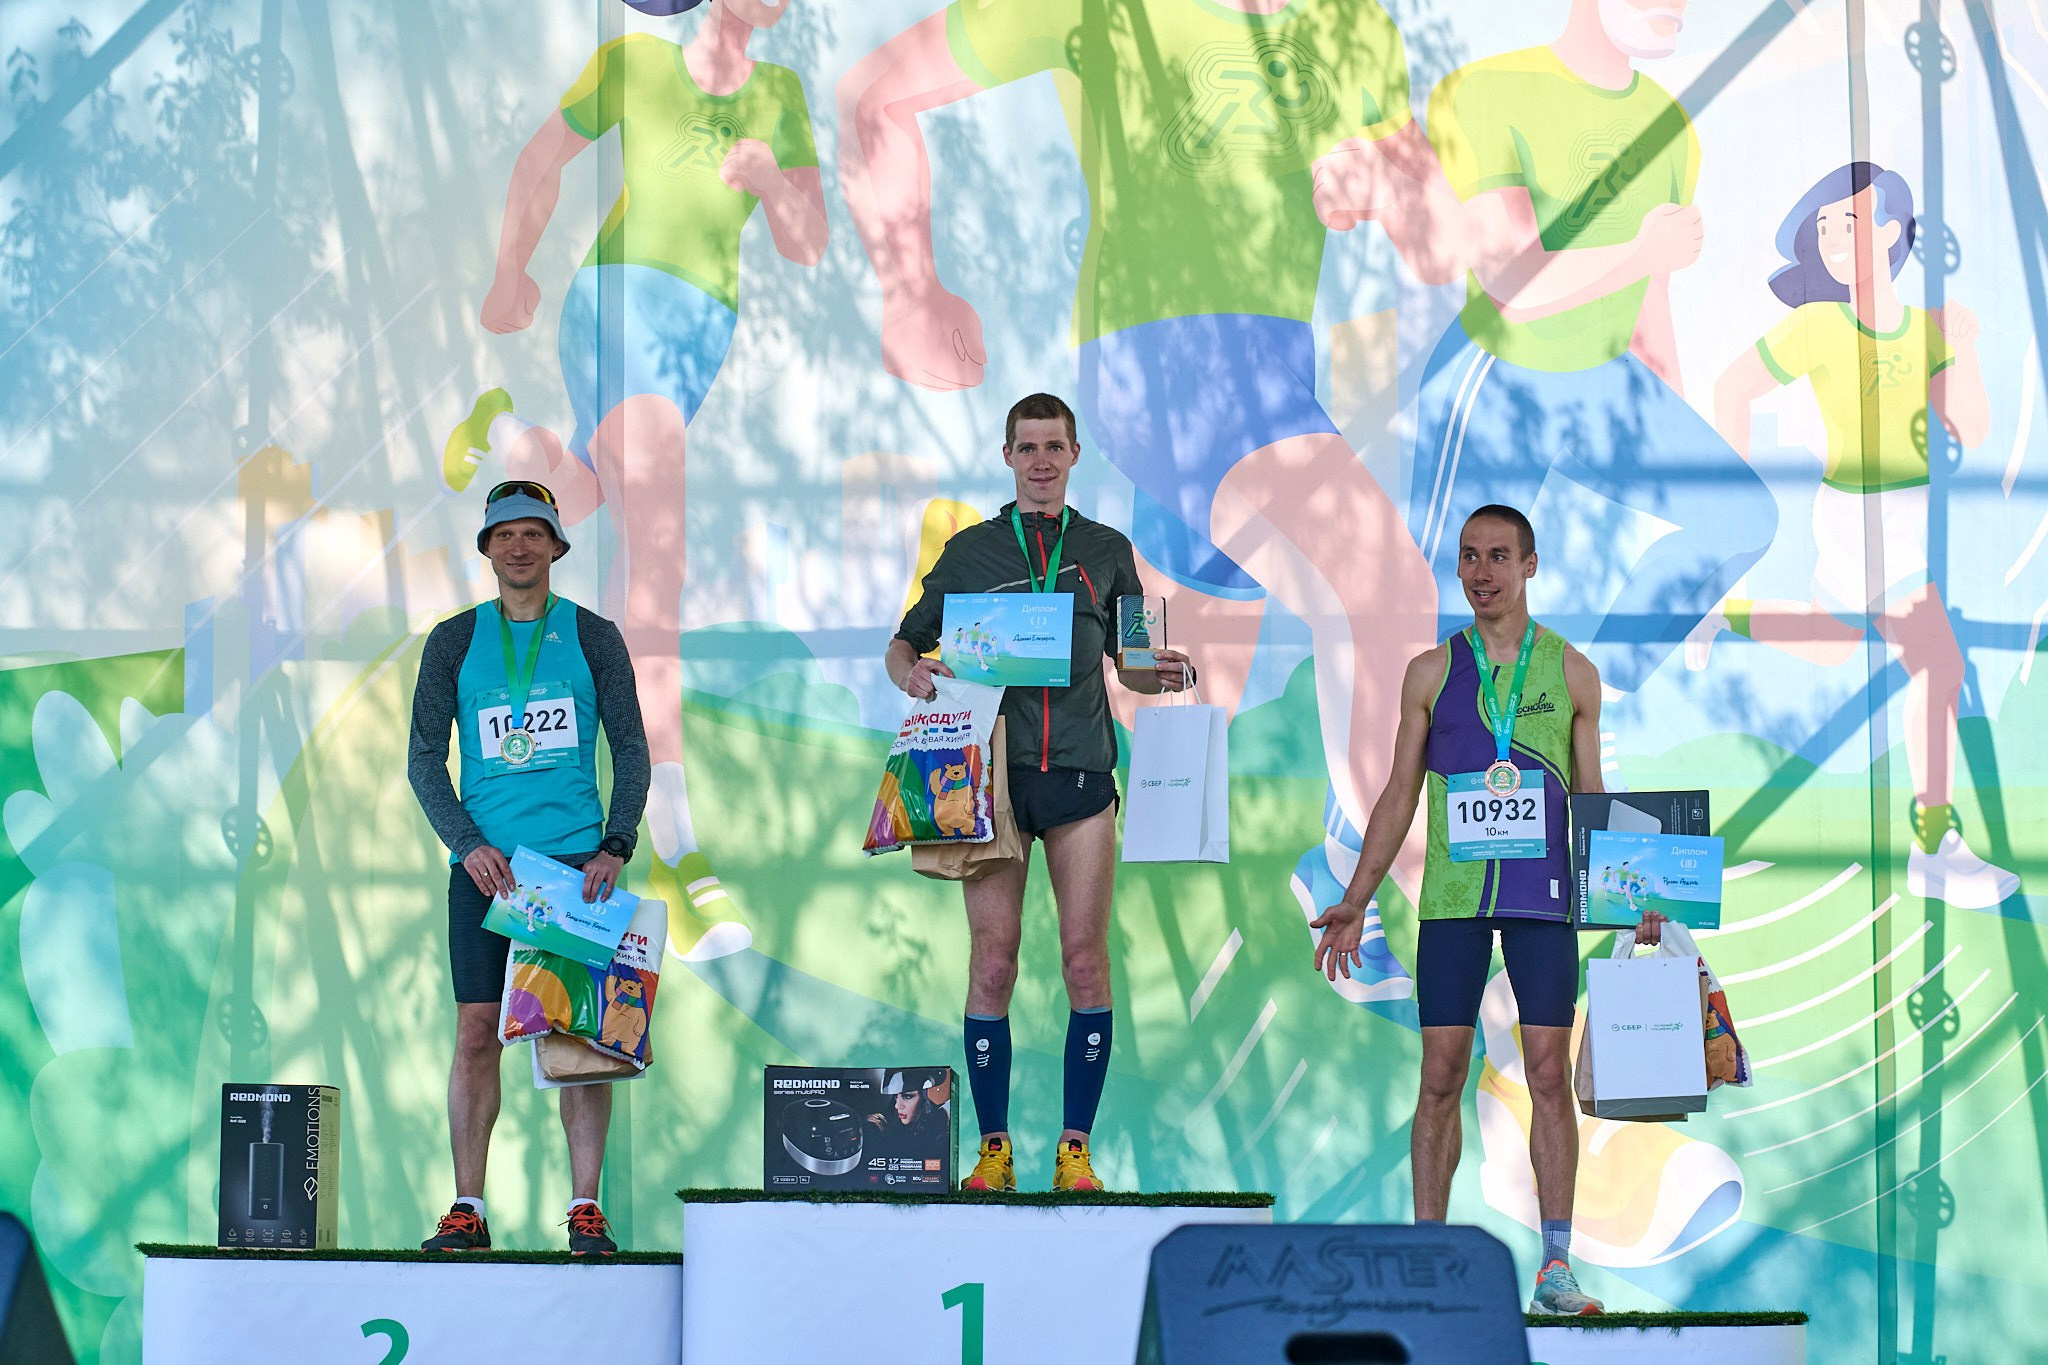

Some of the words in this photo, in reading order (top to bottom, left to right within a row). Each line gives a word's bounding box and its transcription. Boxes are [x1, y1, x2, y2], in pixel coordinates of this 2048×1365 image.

[1022, 604, 1058, 613] Диплом
[1458, 798, 1536, 824] 10932
[1670, 846, 1708, 856] Диплом
[1579, 870, 1588, 923] REDMOND
[616, 951, 647, 964] ХИМИЯ
[774, 1079, 840, 1089] REDMOND
[230, 1092, 291, 1103] REDMOND
[306, 1086, 321, 1170] EMOTIONS
[868, 1158, 886, 1167] 45
[1205, 1236, 1470, 1296] MASTER
[942, 1282, 984, 1365] 1
